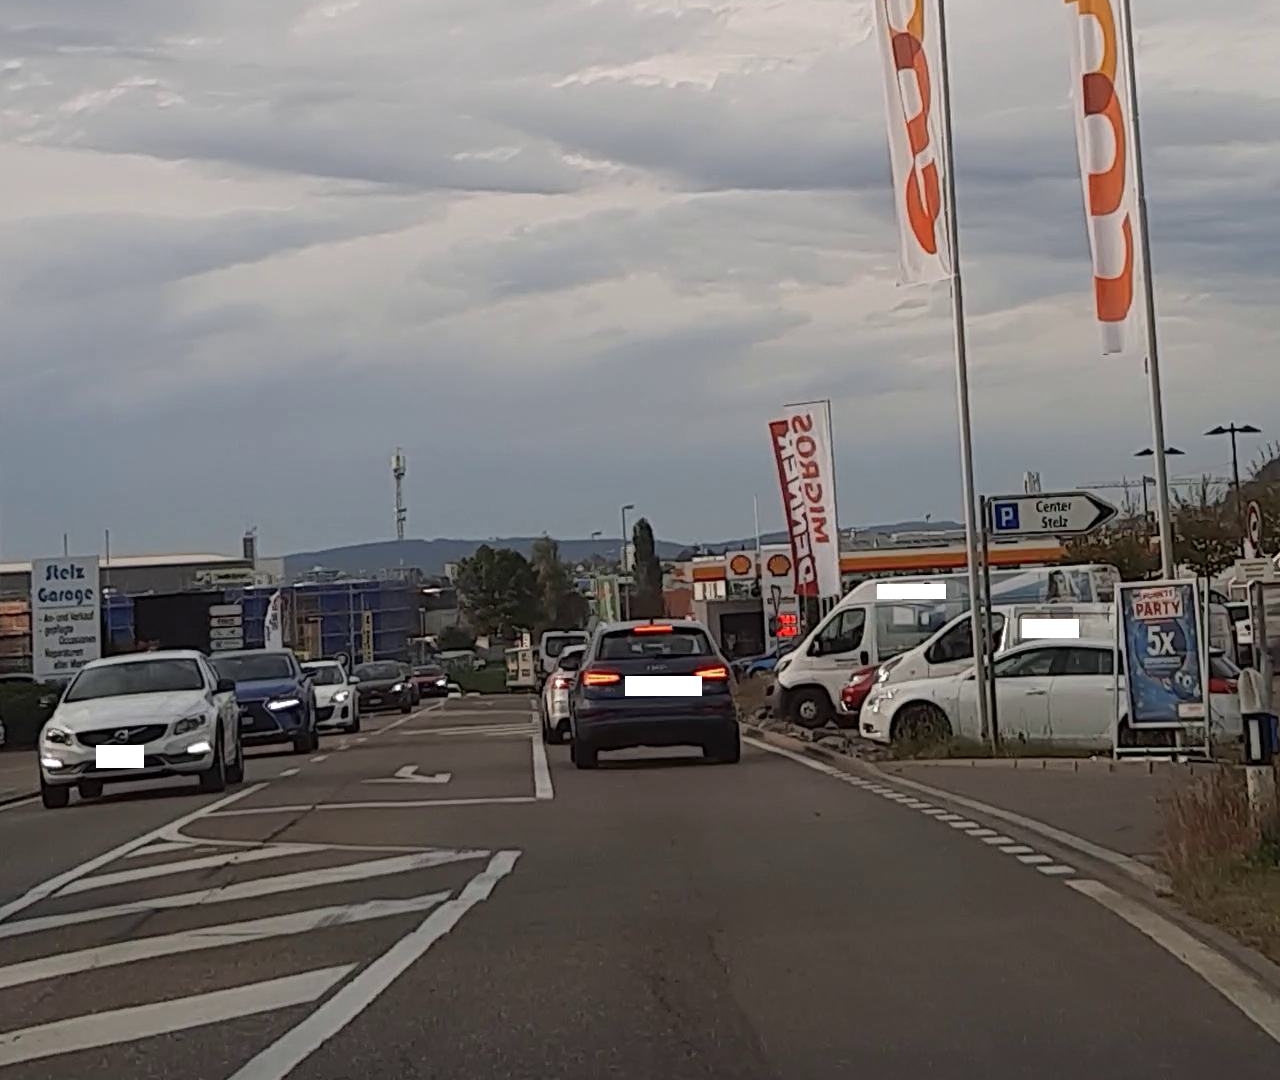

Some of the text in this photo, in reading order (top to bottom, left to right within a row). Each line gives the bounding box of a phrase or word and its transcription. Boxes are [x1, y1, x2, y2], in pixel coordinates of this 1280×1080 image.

[1036, 501, 1072, 513] Center
[1041, 515, 1069, 528] Stelz
[46, 564, 85, 581] Stelz
[38, 588, 94, 605] Garage
[1135, 601, 1180, 617] PARTY
